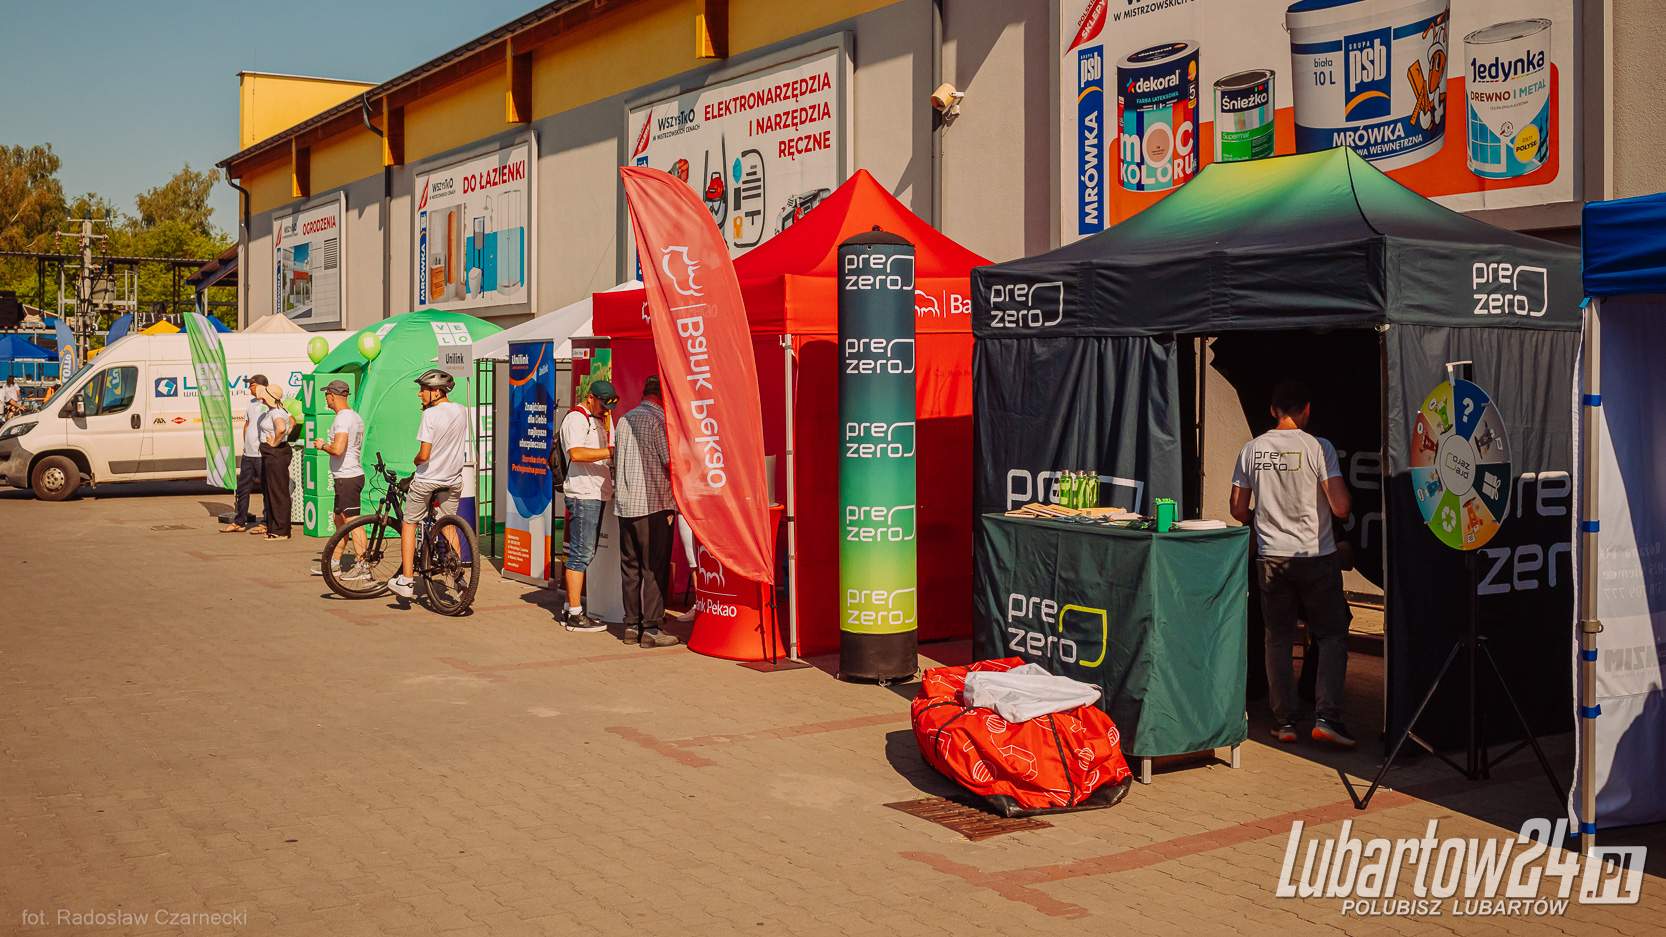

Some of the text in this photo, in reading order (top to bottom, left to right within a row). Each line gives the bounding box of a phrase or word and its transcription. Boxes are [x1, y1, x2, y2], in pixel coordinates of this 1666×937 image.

[1348, 40, 1371, 50] GRUPA
[1080, 51, 1101, 88] psb
[1313, 58, 1333, 68] biała
[1349, 38, 1387, 93] psb
[1136, 69, 1179, 93] dekoral
[1313, 70, 1336, 86] 10 L
[703, 71, 831, 122] ELEKTRONARZĘDZIA
[1189, 84, 1196, 100] 5
[1470, 90, 1511, 102] DREWNO
[1519, 78, 1547, 98] METAL
[749, 102, 831, 137] I NARZĘDZIA
[1332, 122, 1405, 147] MRÓWKA
[1369, 134, 1423, 155] WEWNĘTRZNA
[778, 130, 831, 161] RĘCZNE
[463, 160, 525, 194] DO ŁAZIENKI
[1081, 111, 1099, 225] MRÓWKA
[1120, 153, 1194, 185] KOLORU
[302, 215, 337, 236] OGRODZENIA
[845, 254, 886, 274] pre
[845, 275, 902, 290] zero
[1472, 262, 1512, 290] pre
[950, 294, 971, 314] Ba
[990, 284, 1028, 308] pre
[1473, 293, 1529, 316] zero
[990, 309, 1043, 328] zero
[846, 338, 887, 357] pre
[445, 352, 465, 364] Unilink
[846, 359, 903, 374] zero
[846, 422, 888, 441] pre
[846, 443, 903, 458] zero
[1254, 462, 1288, 471] zero
[846, 505, 887, 524] pre
[846, 527, 903, 541] zero
[1477, 542, 1572, 596] zer
[847, 589, 888, 607] pre
[1007, 593, 1059, 623] pre
[706, 599, 738, 618] Pekao
[847, 609, 904, 625] zero
[1007, 627, 1077, 664] zero
